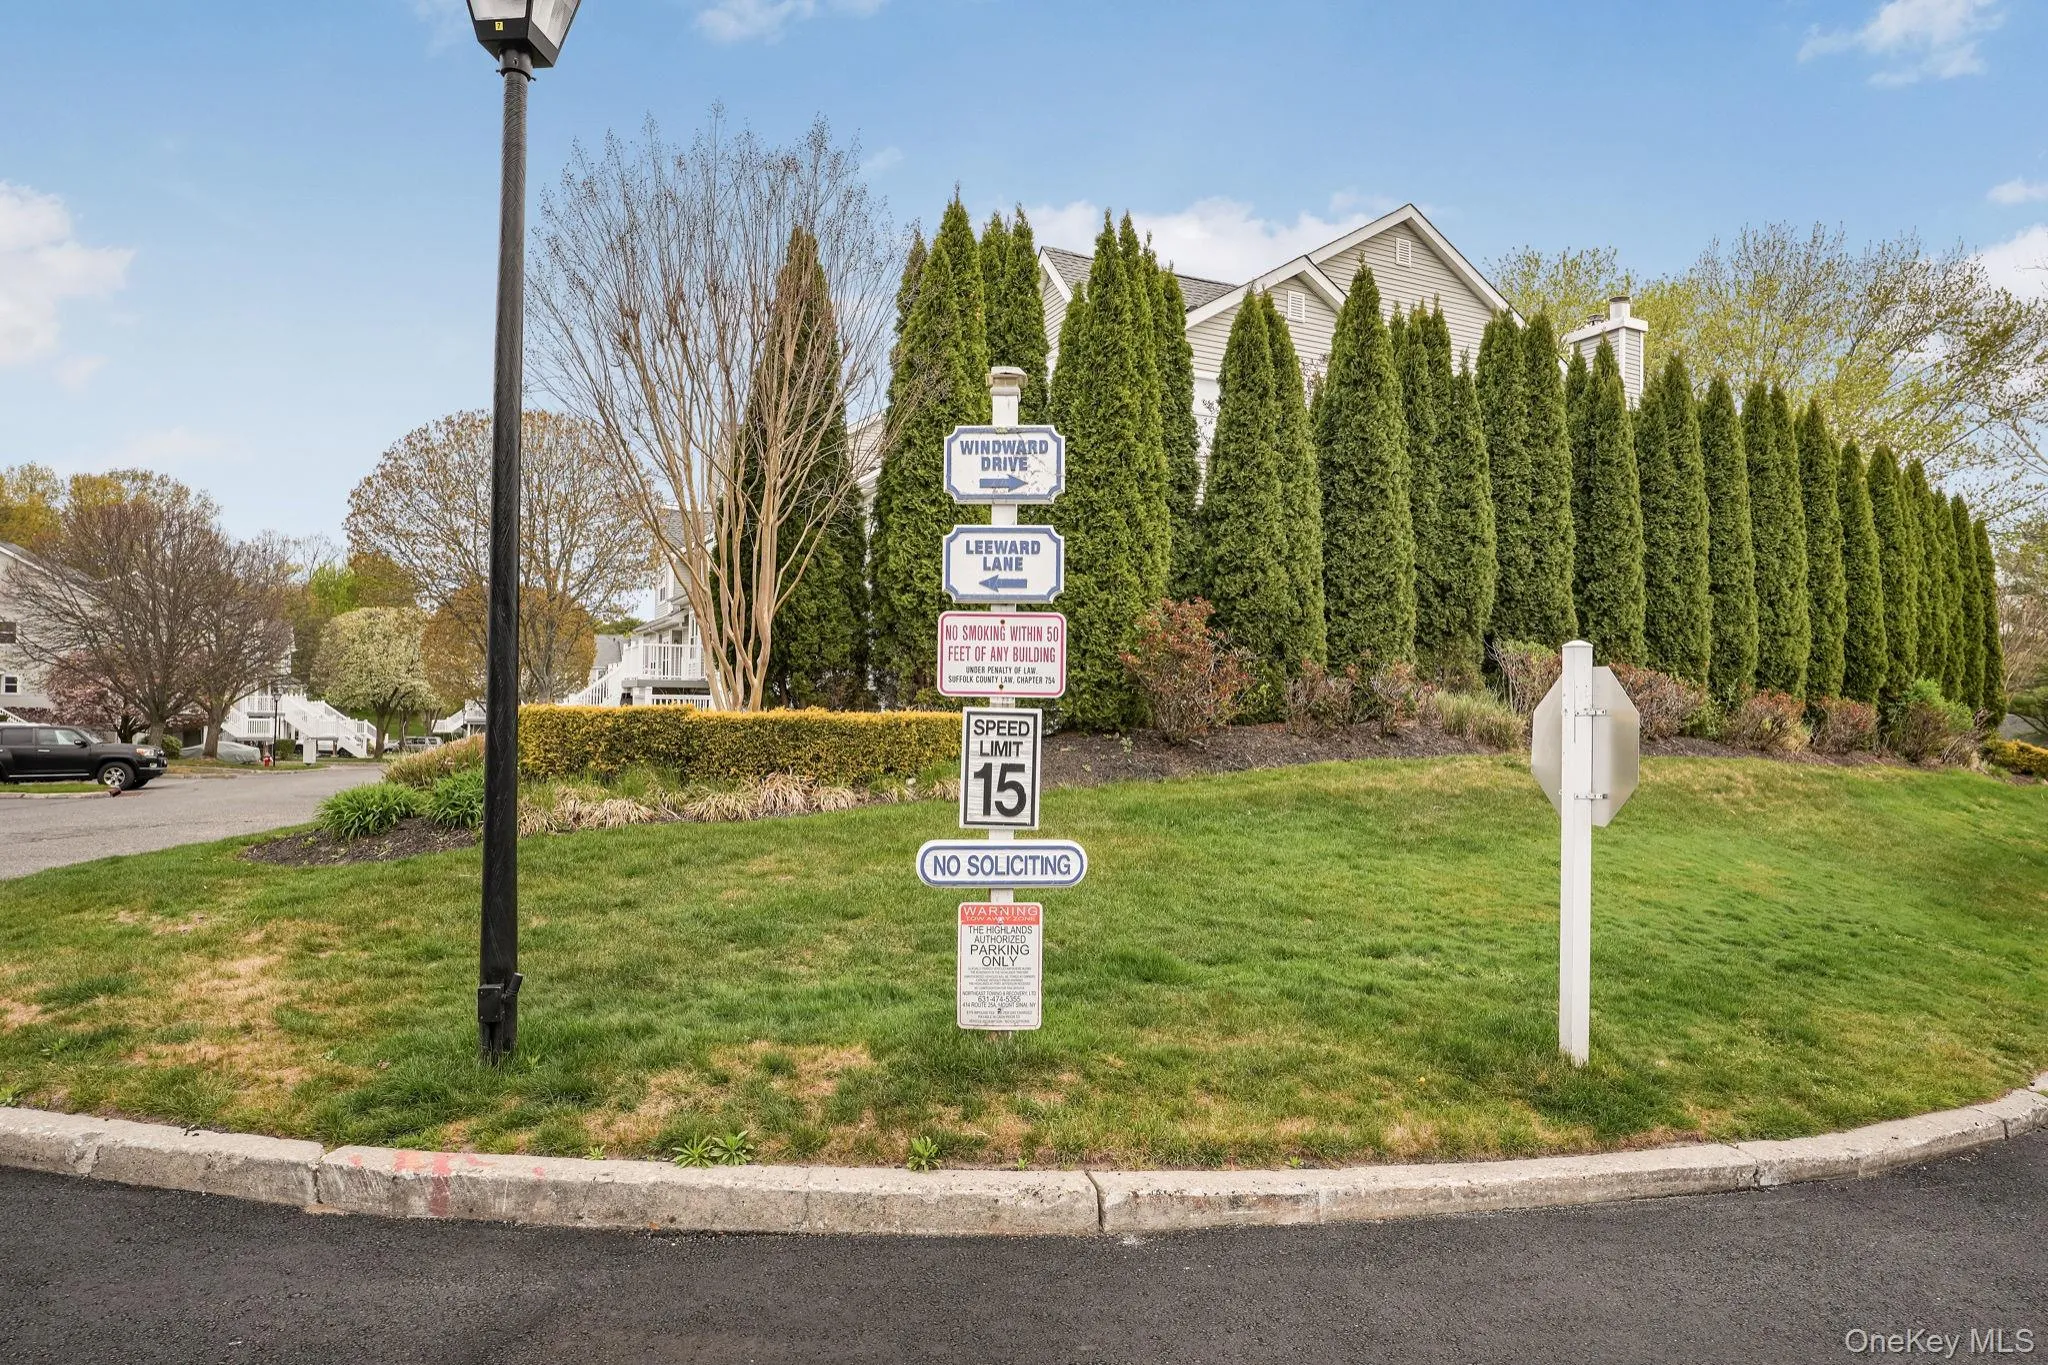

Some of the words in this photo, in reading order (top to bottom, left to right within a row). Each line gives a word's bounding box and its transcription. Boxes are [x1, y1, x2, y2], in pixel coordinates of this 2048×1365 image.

[960, 440, 1049, 455] WINDWARD
[981, 456, 1028, 471] DRIVE
[966, 540, 1041, 555] LEEWARD
[982, 556, 1023, 571] LANE
[946, 625, 958, 641] NO
[962, 625, 1005, 641] SMOKING
[1010, 625, 1043, 642] WITHIN
[1047, 626, 1059, 642] 50
[948, 646, 971, 661] FEET
[975, 646, 987, 662] OF
[990, 646, 1009, 662] ANY
[1013, 647, 1056, 663] BUILDING
[966, 666, 985, 674] UNDER
[988, 666, 1012, 674] PENALTY
[1014, 666, 1021, 674] OF
[948, 675, 973, 683] SUFFOLK
[976, 676, 998, 684] COUNTY
[974, 719, 1030, 736] SPEED
[980, 740, 1023, 757] LIMIT
[974, 762, 1026, 817] 15
[934, 855, 961, 876] NO
[967, 854, 1071, 876] SOLICITING
[963, 906, 1038, 916] WARNING
[969, 926, 984, 934] THE
[986, 926, 1033, 934] HIGHLANDS
[974, 935, 1026, 943] AUTHORIZED
[971, 944, 1030, 955] PARKING
[982, 956, 1018, 967] ONLY
